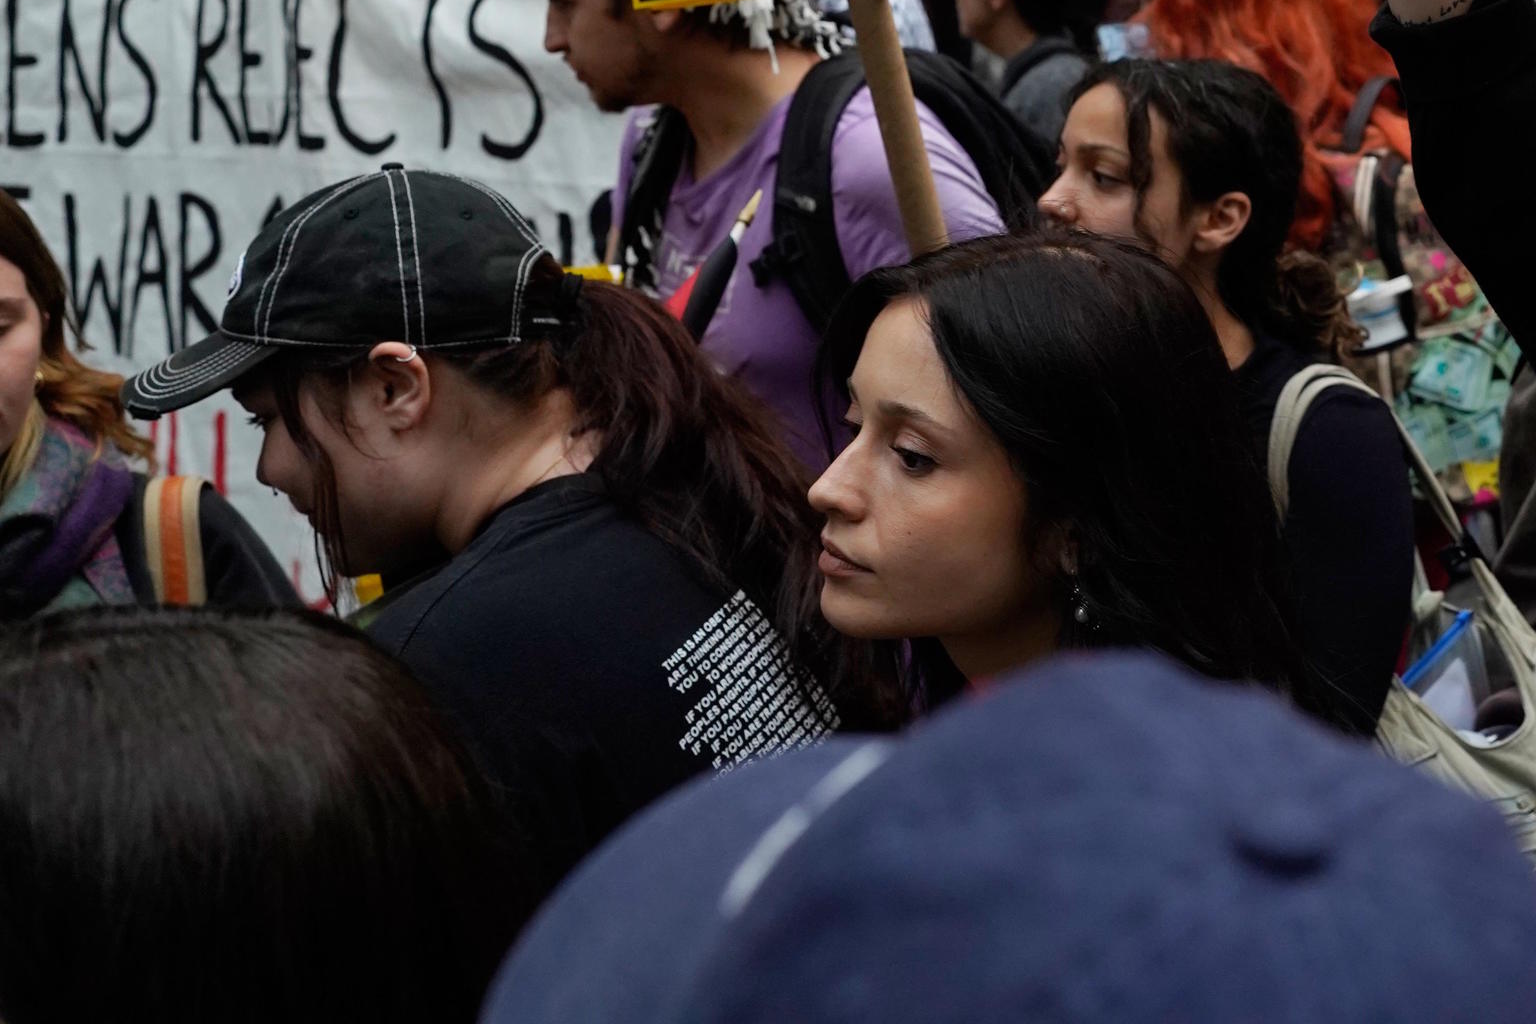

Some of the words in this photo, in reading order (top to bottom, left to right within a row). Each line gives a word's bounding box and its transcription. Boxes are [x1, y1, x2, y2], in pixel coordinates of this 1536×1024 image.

[65, 191, 223, 360] WAR
[662, 648, 687, 671] THIS
[683, 639, 695, 651] IS
[692, 628, 706, 644] AN
[703, 608, 725, 632] OBEY
[668, 663, 688, 687] ARE
[686, 629, 725, 667] THINKING
[676, 670, 699, 694] YOU
[697, 659, 711, 674] TO
[709, 624, 748, 663] CONSIDER
[706, 669, 720, 684] TO
[747, 631, 755, 644] IF
[754, 619, 769, 636] YOU
[679, 705, 721, 750] PEOPLES
[747, 666, 756, 679] IF
[755, 651, 772, 670] YOU
[685, 710, 695, 724] IF
[694, 690, 717, 712] YOU
[716, 673, 734, 695] ARE
[691, 740, 701, 755] IF
[700, 720, 722, 743] YOU
[721, 671, 771, 724] PARTICIPATE
[768, 664, 778, 676] IN
[711, 738, 720, 753] IF
[720, 719, 742, 742] YOU
[740, 697, 763, 722] TURN
[761, 692, 770, 702] A
[712, 755, 722, 769] IF
[721, 735, 744, 758] YOU
[744, 717, 762, 740] ARE
[735, 732, 764, 765] ABUSE
[762, 711, 786, 736] YOUR
[756, 734, 779, 758] THEN
[777, 717, 796, 738] THIS
